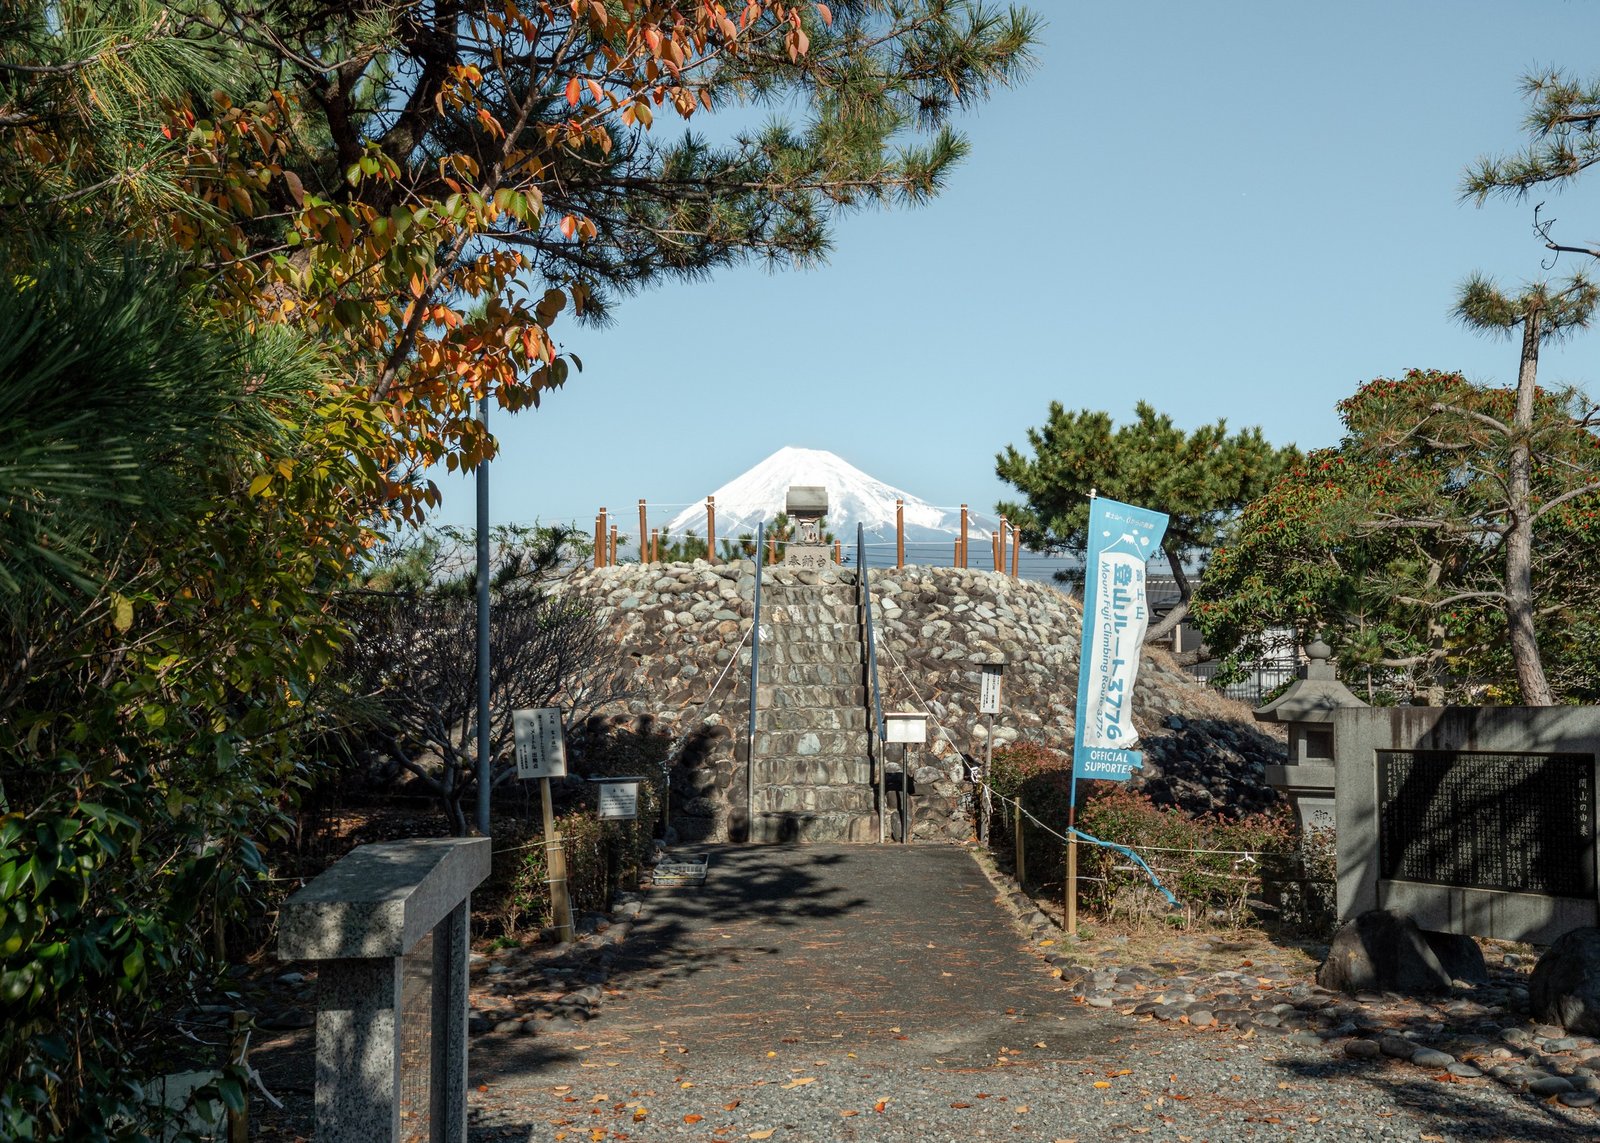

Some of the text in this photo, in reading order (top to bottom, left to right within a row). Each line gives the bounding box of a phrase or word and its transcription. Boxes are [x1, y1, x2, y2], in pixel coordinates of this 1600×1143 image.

[788, 555, 826, 567] 奉納台
[1101, 561, 1110, 597] Mount
[1136, 569, 1145, 619] 富士山
[1101, 600, 1111, 620] Fuji
[1100, 622, 1112, 672] Climbing
[1099, 675, 1109, 706] Route
[1084, 761, 1133, 774] SUPPORTER
[1090, 750, 1128, 763] OFFICIAL
